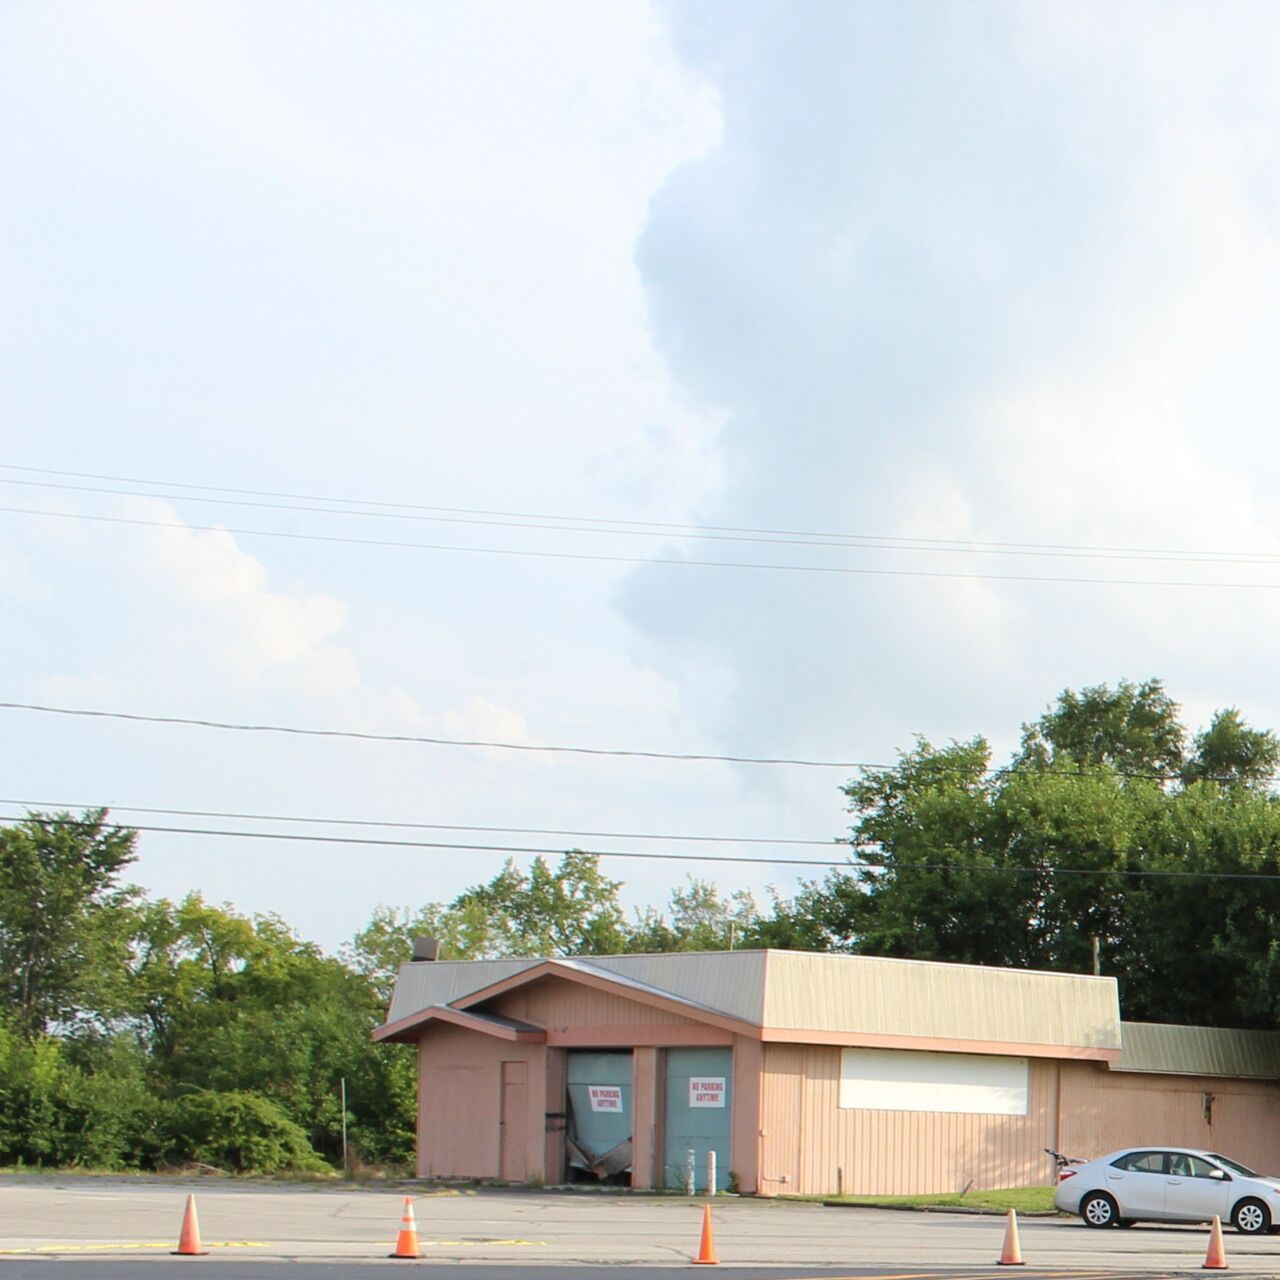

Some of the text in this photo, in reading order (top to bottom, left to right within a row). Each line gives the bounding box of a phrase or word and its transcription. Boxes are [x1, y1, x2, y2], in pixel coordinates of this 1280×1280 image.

[701, 1082, 723, 1092] PARKING
[600, 1090, 620, 1098] PARKING
[696, 1093, 719, 1102] ANYTIME
